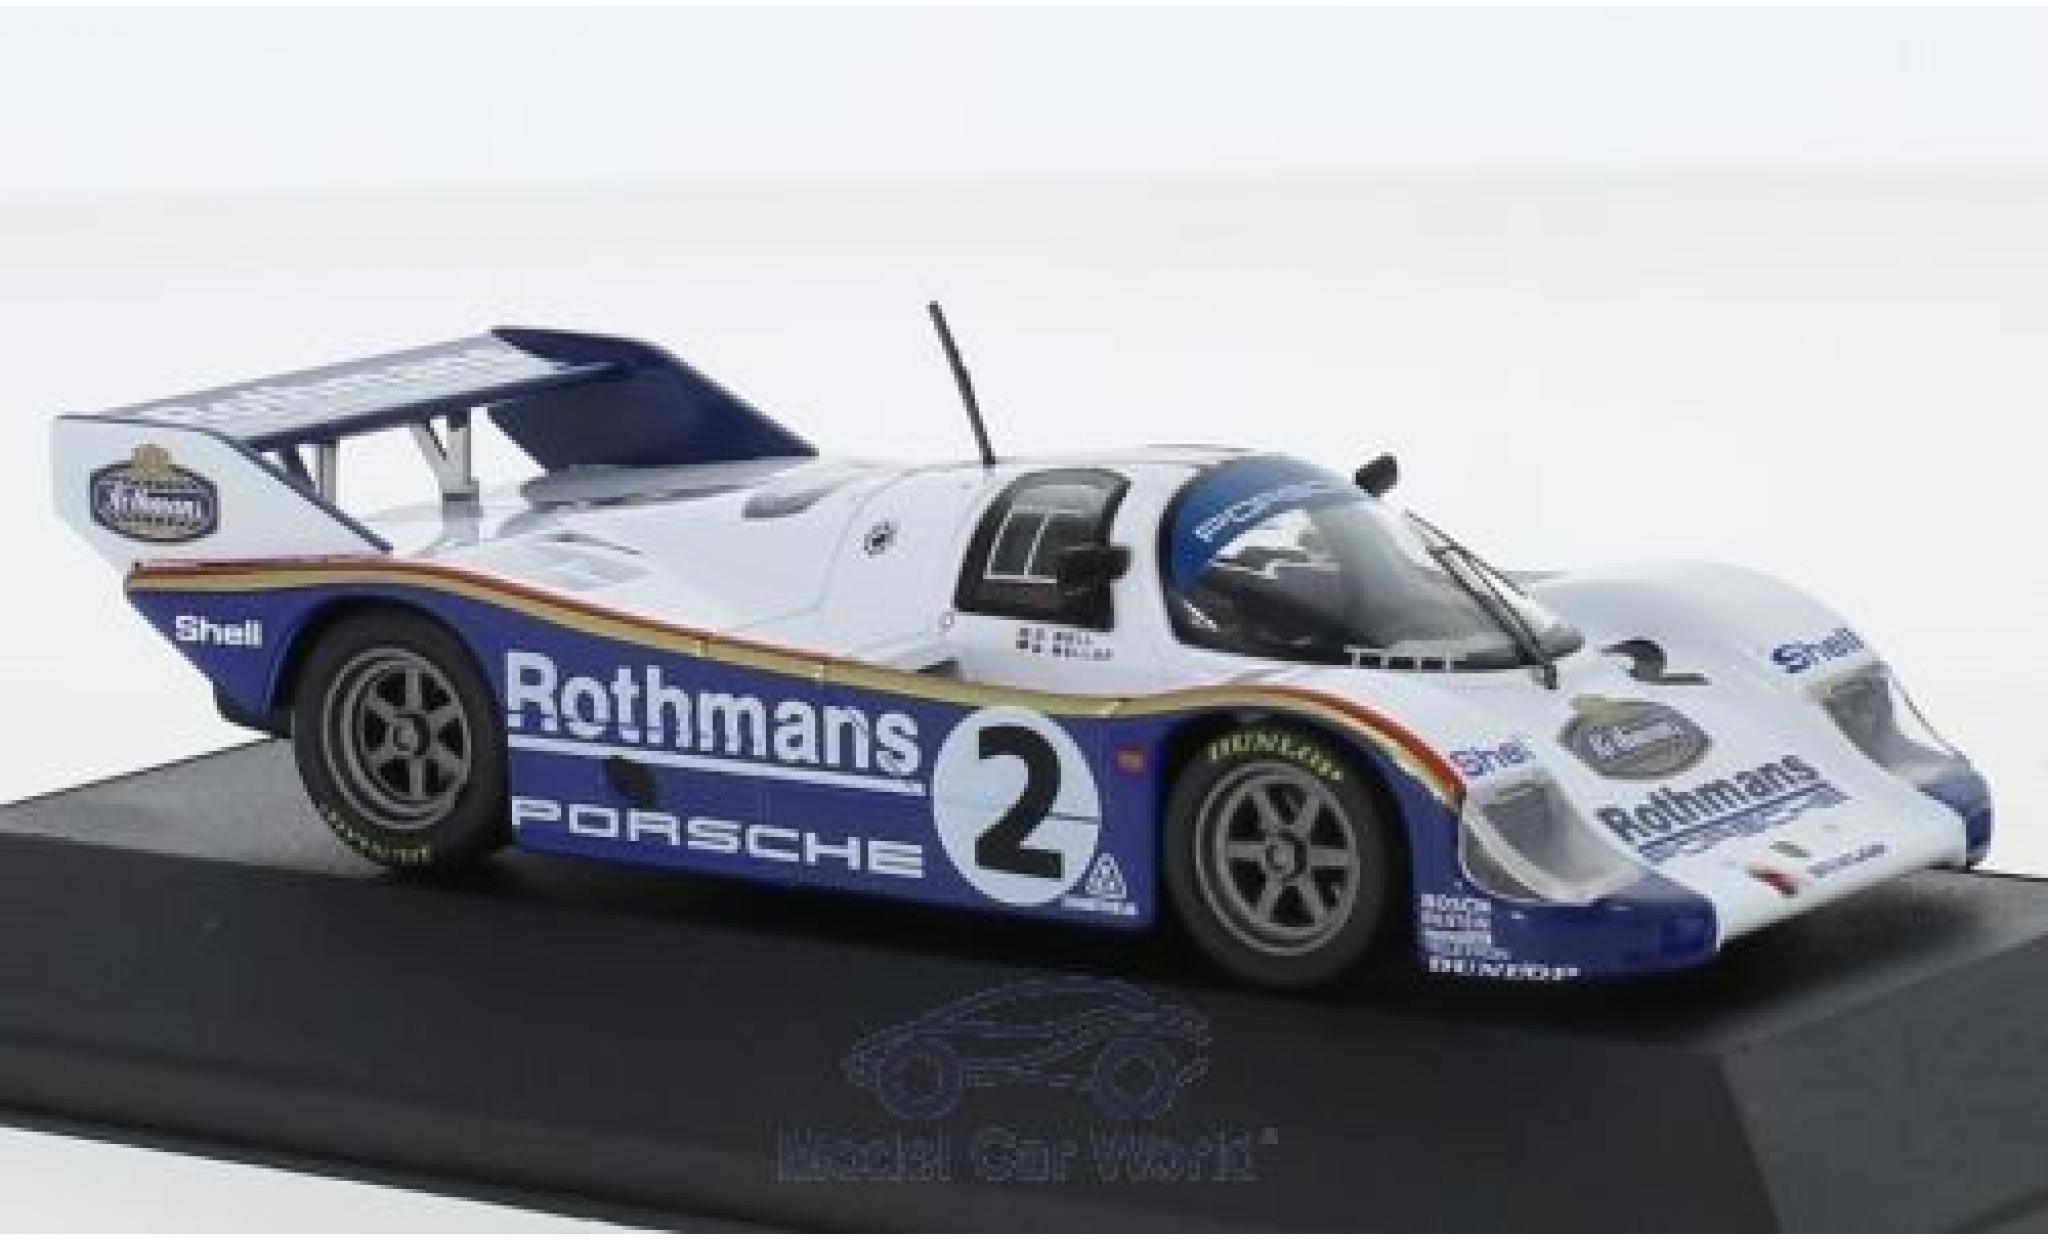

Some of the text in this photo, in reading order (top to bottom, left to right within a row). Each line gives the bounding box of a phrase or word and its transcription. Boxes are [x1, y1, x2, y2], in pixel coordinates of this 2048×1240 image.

[174, 614, 263, 648] Shell
[1771, 625, 1866, 674] Shell
[506, 650, 923, 777] Rothmans
[511, 795, 925, 879] PORSCHE
[973, 724, 1066, 880] 2
[1595, 753, 1820, 844] Rothmans
[1428, 956, 1581, 983] DUNLOP
